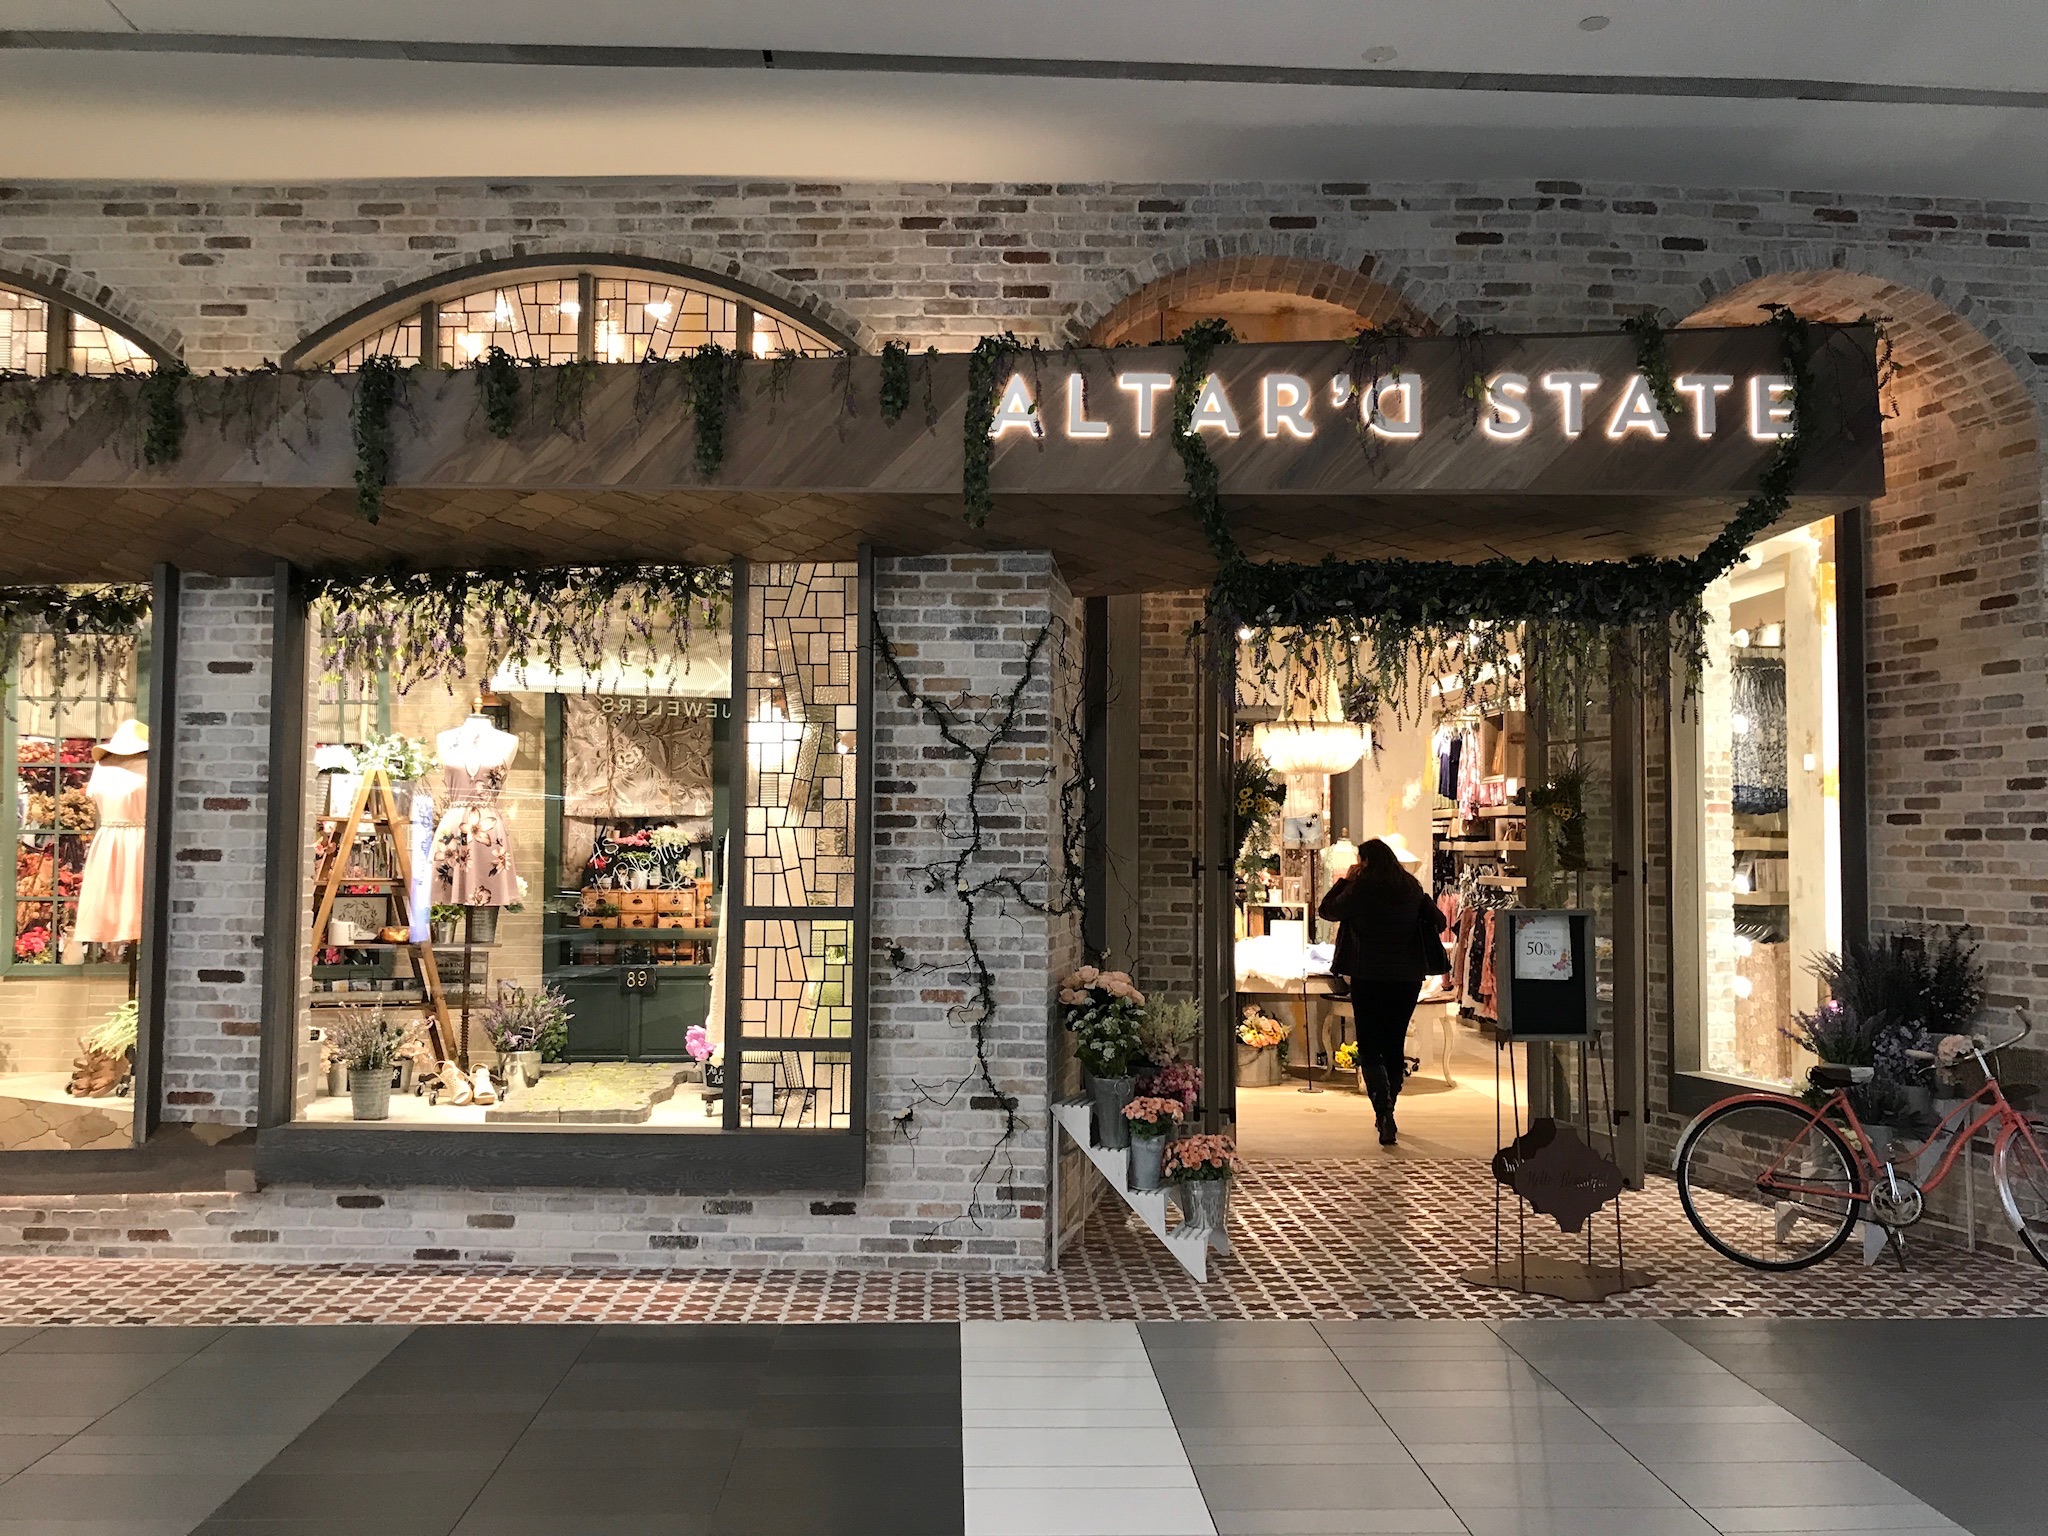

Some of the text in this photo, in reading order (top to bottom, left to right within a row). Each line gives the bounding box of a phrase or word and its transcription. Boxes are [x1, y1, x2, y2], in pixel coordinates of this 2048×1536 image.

[988, 371, 1799, 439] ALTAR'D STATE
[626, 970, 648, 988] 89
